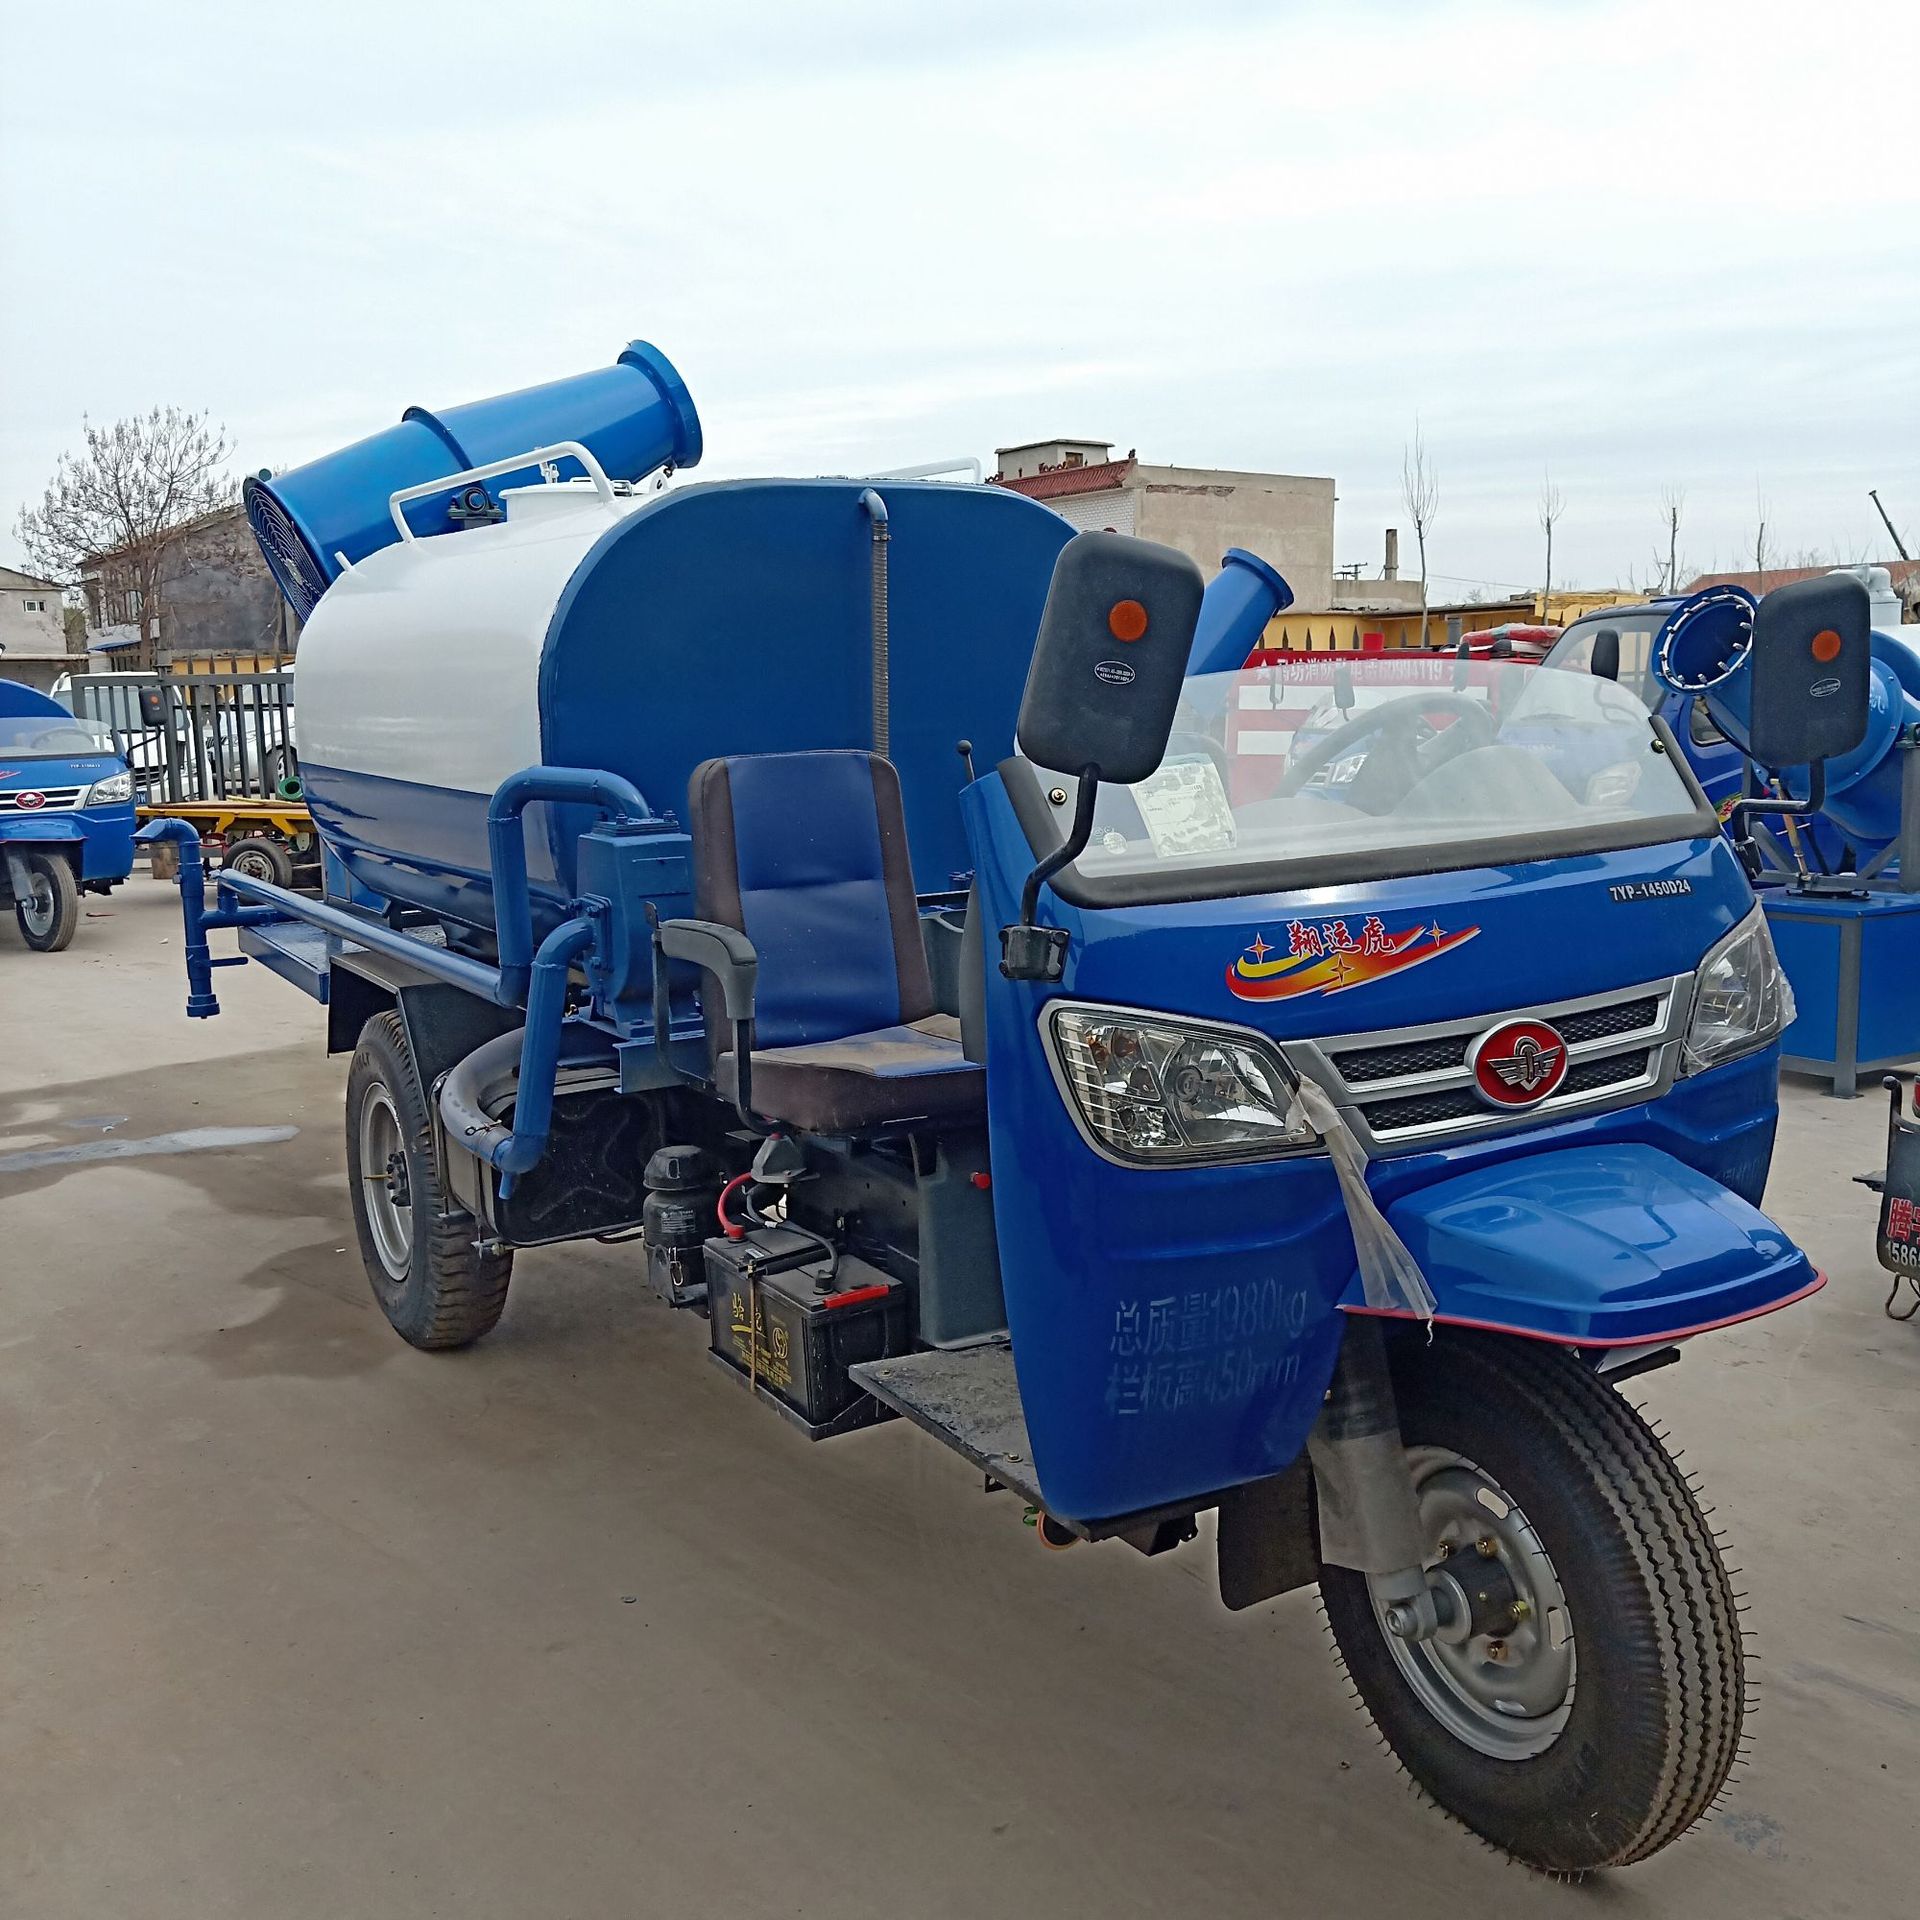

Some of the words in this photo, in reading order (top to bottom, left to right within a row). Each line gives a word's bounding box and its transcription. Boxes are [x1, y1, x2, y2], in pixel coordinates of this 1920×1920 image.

[1610, 879, 1691, 900] 7YP-1450D24
[1286, 916, 1396, 958] 翔运虎
